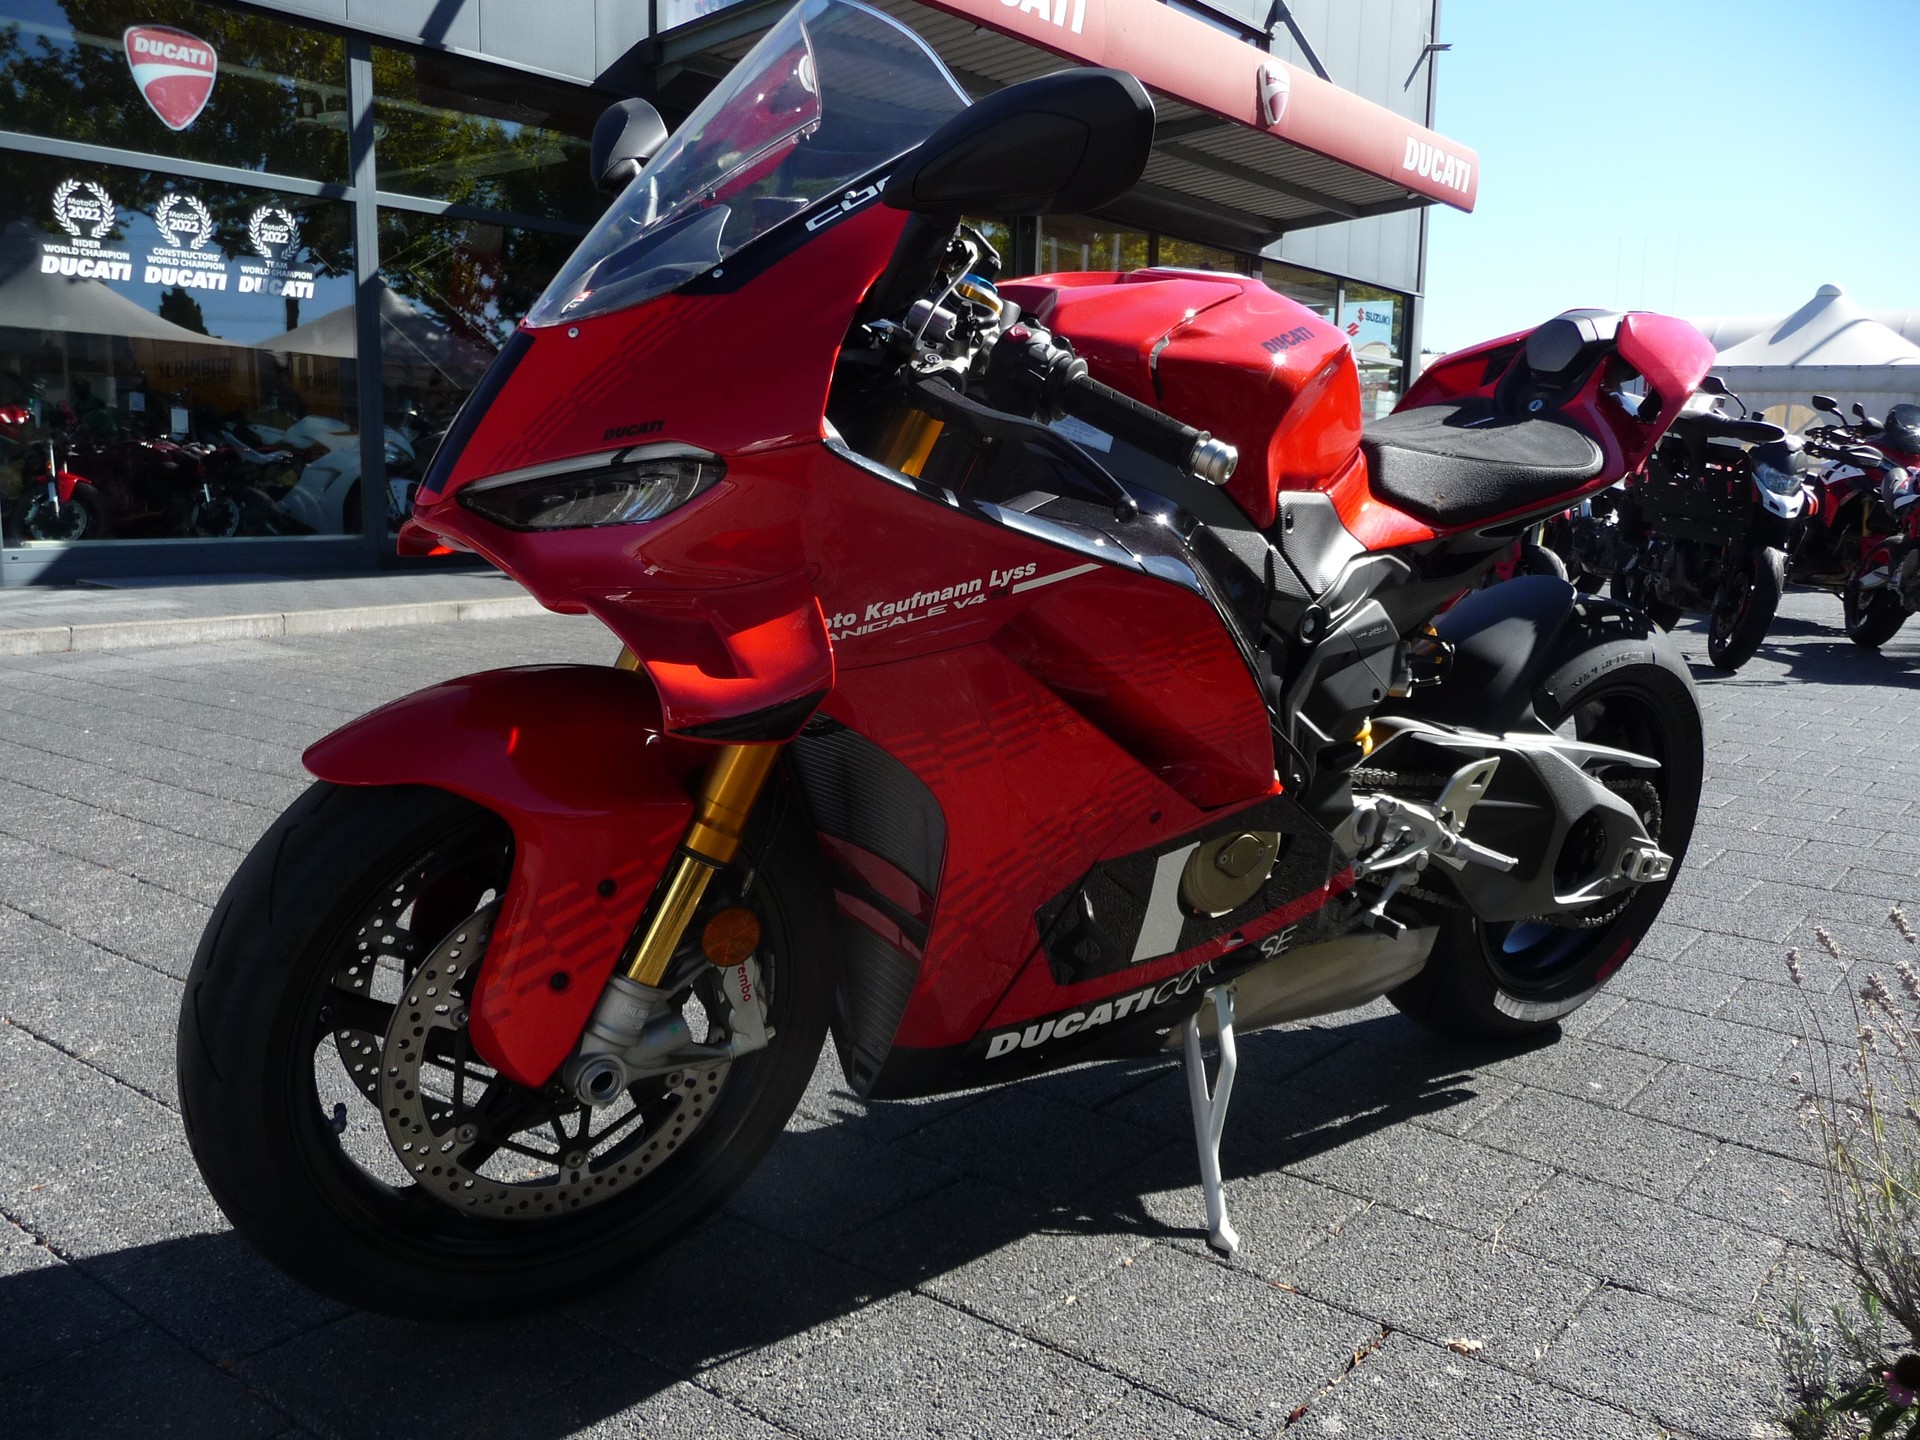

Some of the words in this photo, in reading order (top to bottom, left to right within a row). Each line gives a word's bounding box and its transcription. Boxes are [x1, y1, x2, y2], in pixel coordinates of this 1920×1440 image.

[134, 36, 208, 65] DUCATI
[1402, 135, 1471, 194] DUCATI
[67, 197, 101, 208] MotoGP
[67, 206, 102, 221] 2022
[168, 210, 199, 220] MotoGP
[168, 219, 200, 233] 2022
[260, 222, 289, 232] MotoGP
[72, 238, 101, 249] RIDER
[261, 231, 289, 244] 2022
[43, 244, 79, 256] WORLD
[80, 249, 130, 261] CHAMPION
[41, 255, 132, 281] DUCATI
[147, 255, 179, 266] WORLD
[180, 258, 225, 271] CHAMPION
[265, 260, 288, 269] TEAM
[144, 266, 227, 291] DUCATI
[240, 265, 270, 275] WORLD
[271, 268, 313, 280] CHAMPION
[238, 275, 315, 299] DUCATI
[1365, 311, 1391, 326] SUZUKI
[1260, 326, 1316, 354] DUCATI
[603, 418, 665, 441] DUCATI
[864, 579, 983, 622] Kaufmann
[989, 562, 1037, 588] Lyss
[829, 603, 948, 641] ANIGALE
[953, 594, 987, 609] V4
